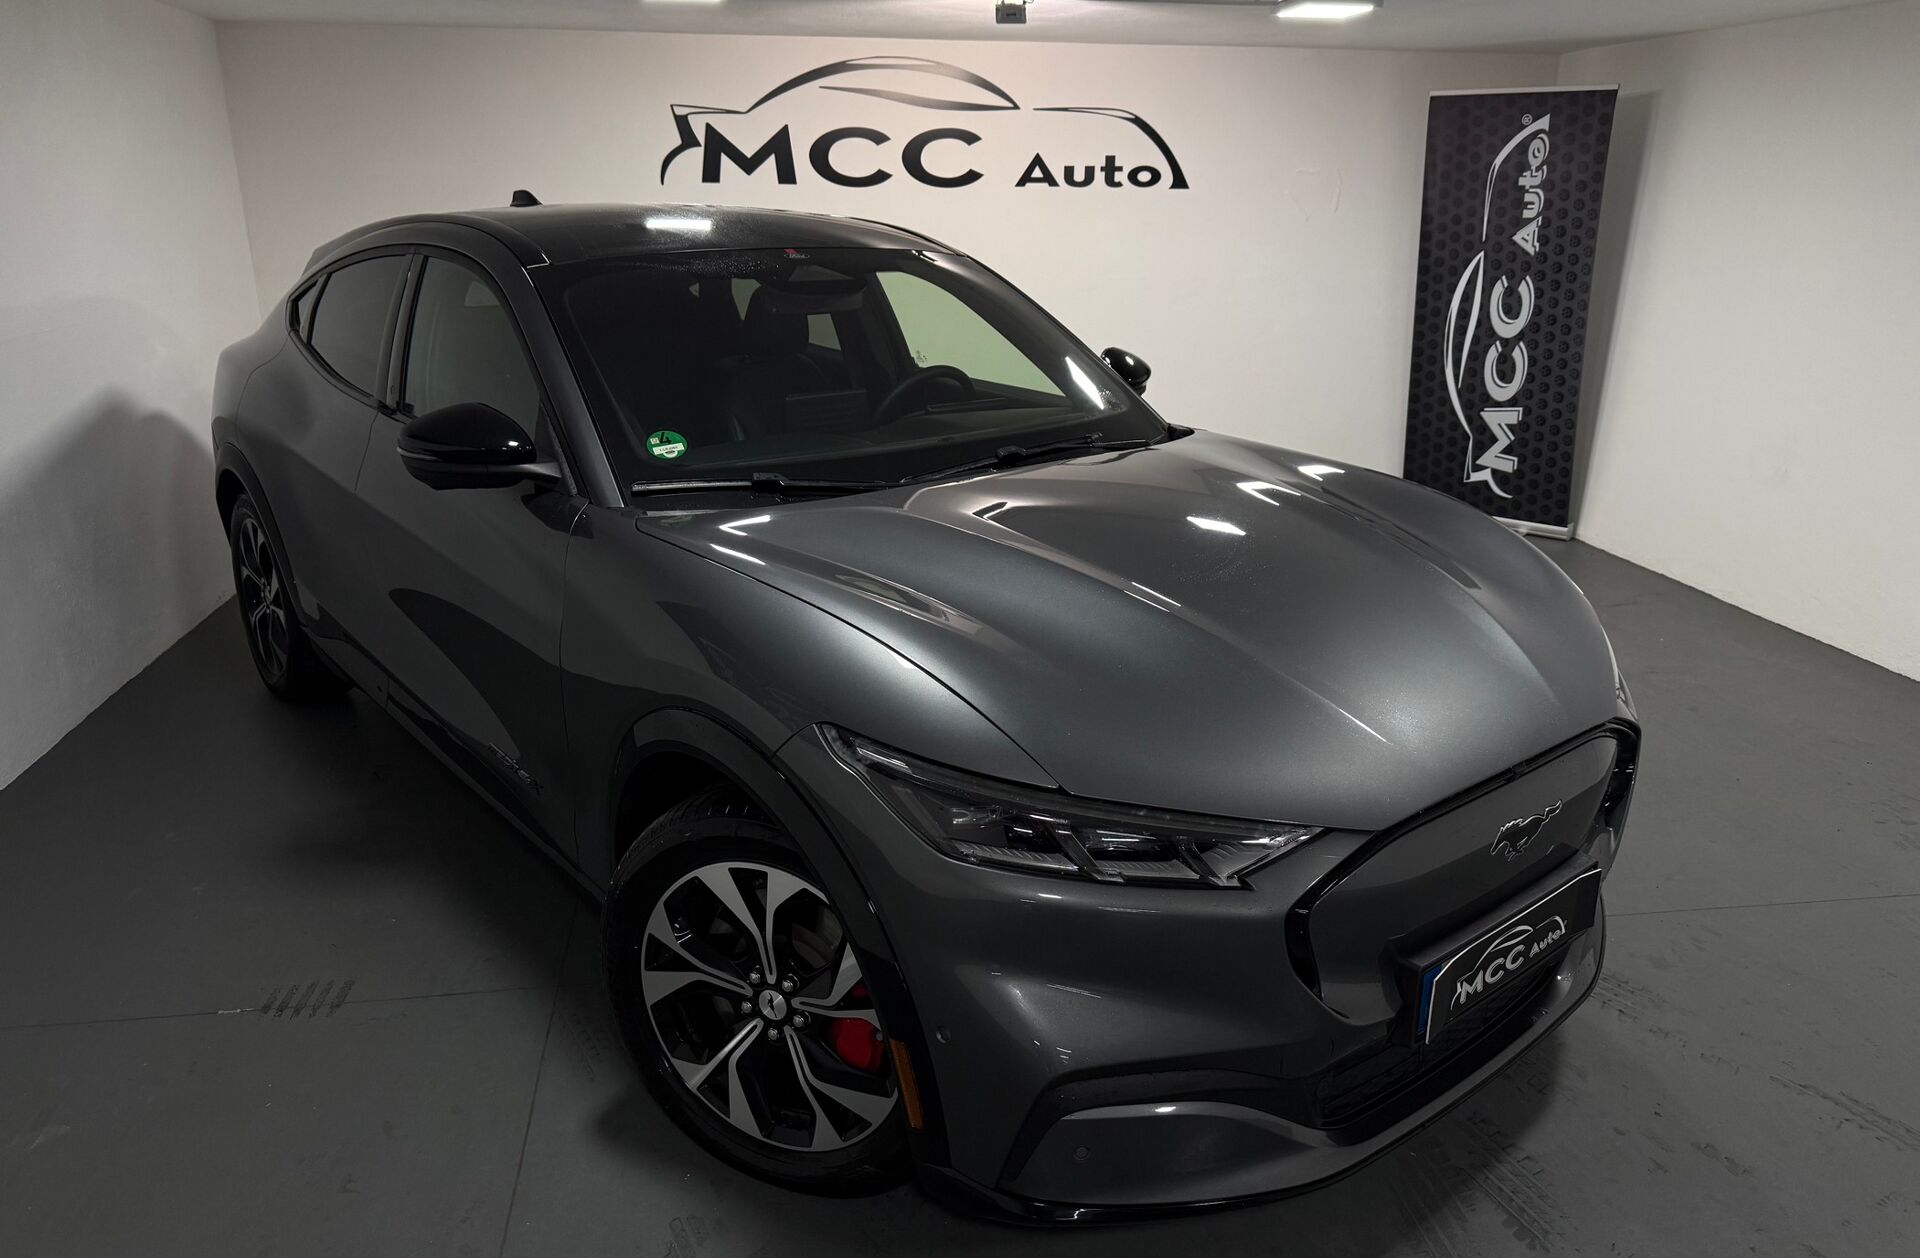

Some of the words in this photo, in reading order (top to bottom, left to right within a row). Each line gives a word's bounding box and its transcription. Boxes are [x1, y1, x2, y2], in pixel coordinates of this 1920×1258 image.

[701, 122, 984, 189] MCC
[1014, 152, 1162, 189] Auto
[1475, 274, 1535, 474] MCC
[1511, 132, 1550, 257] Auto
[660, 431, 671, 444] 4
[1460, 944, 1526, 1004] MCC
[1529, 929, 1562, 958] Auto
